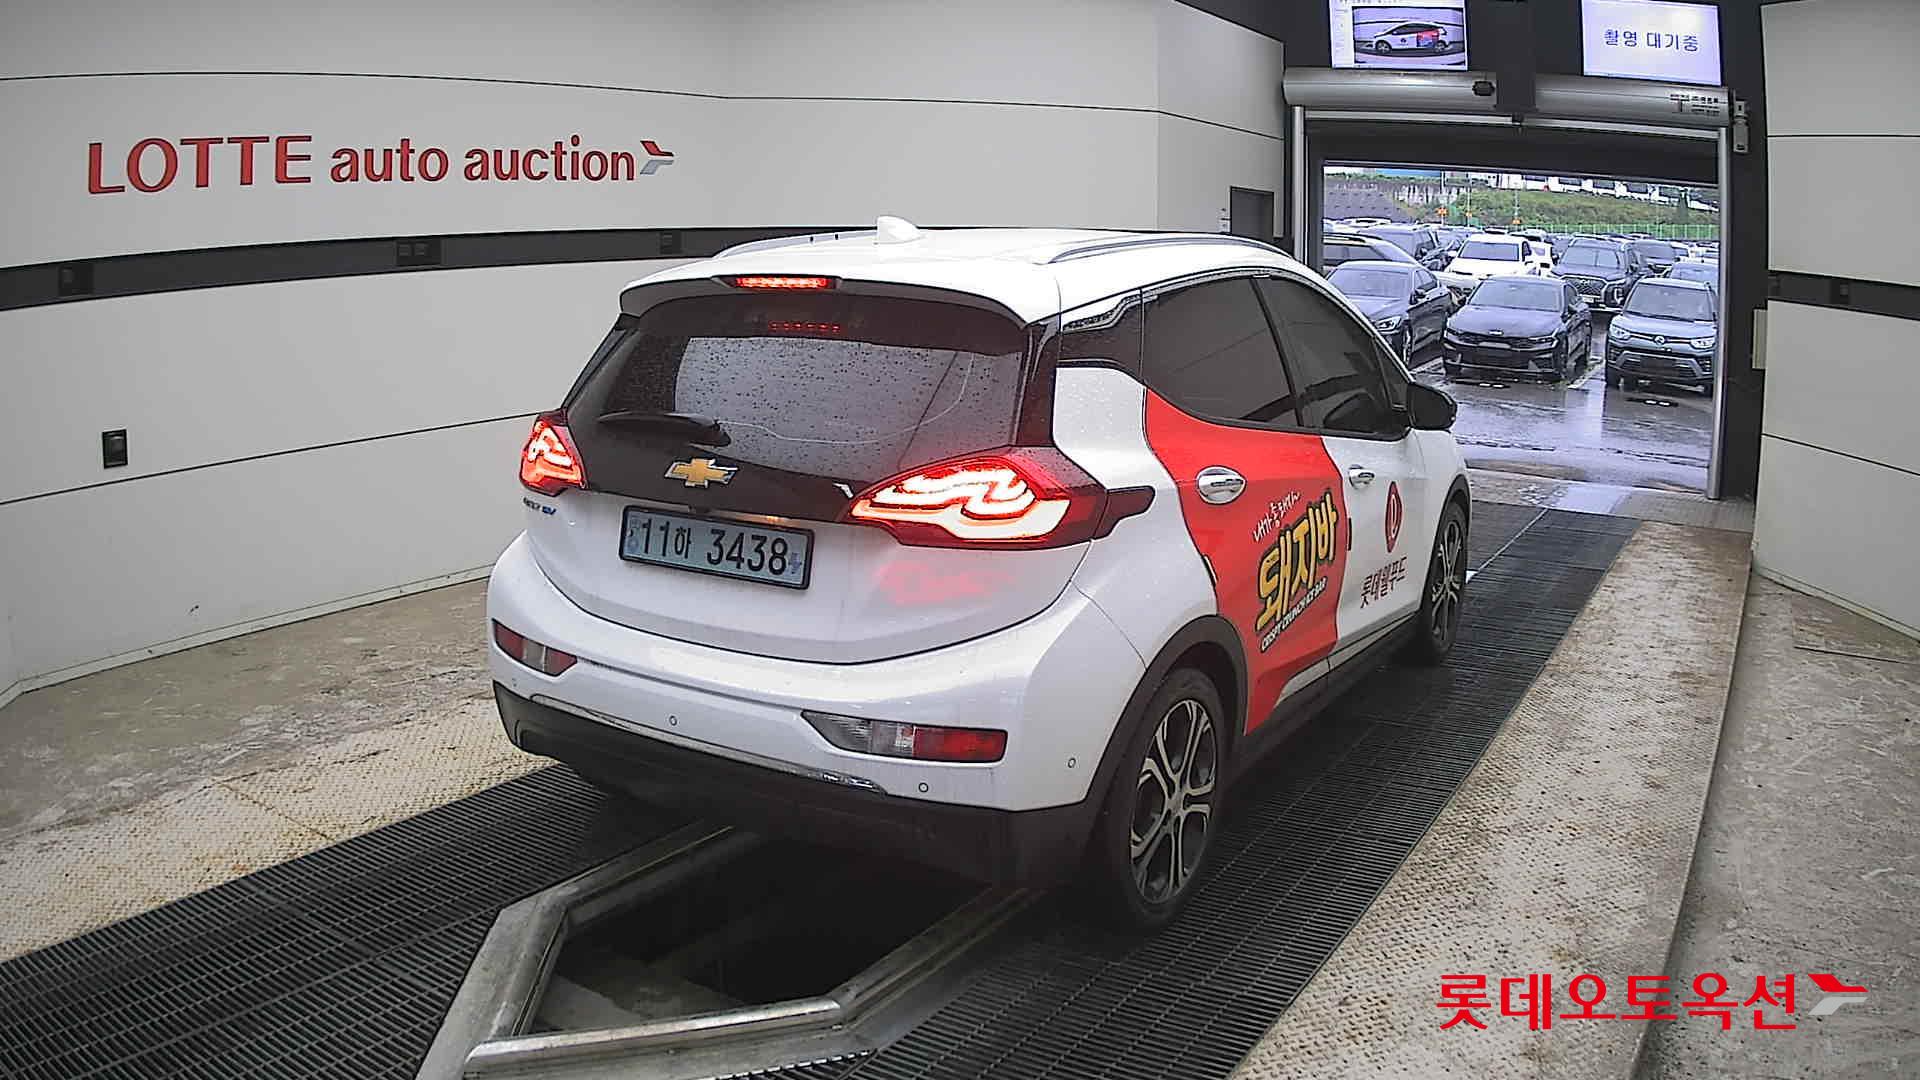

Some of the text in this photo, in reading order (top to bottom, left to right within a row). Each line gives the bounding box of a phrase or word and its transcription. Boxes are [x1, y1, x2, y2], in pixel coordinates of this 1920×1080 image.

[1604, 29, 1698, 52] 촬영 대기중
[87, 135, 635, 194] LOTTE auto auction
[706, 528, 788, 576] 3438
[1255, 491, 1339, 632] 돼지바
[1360, 556, 1407, 609] 롯데웰푸드
